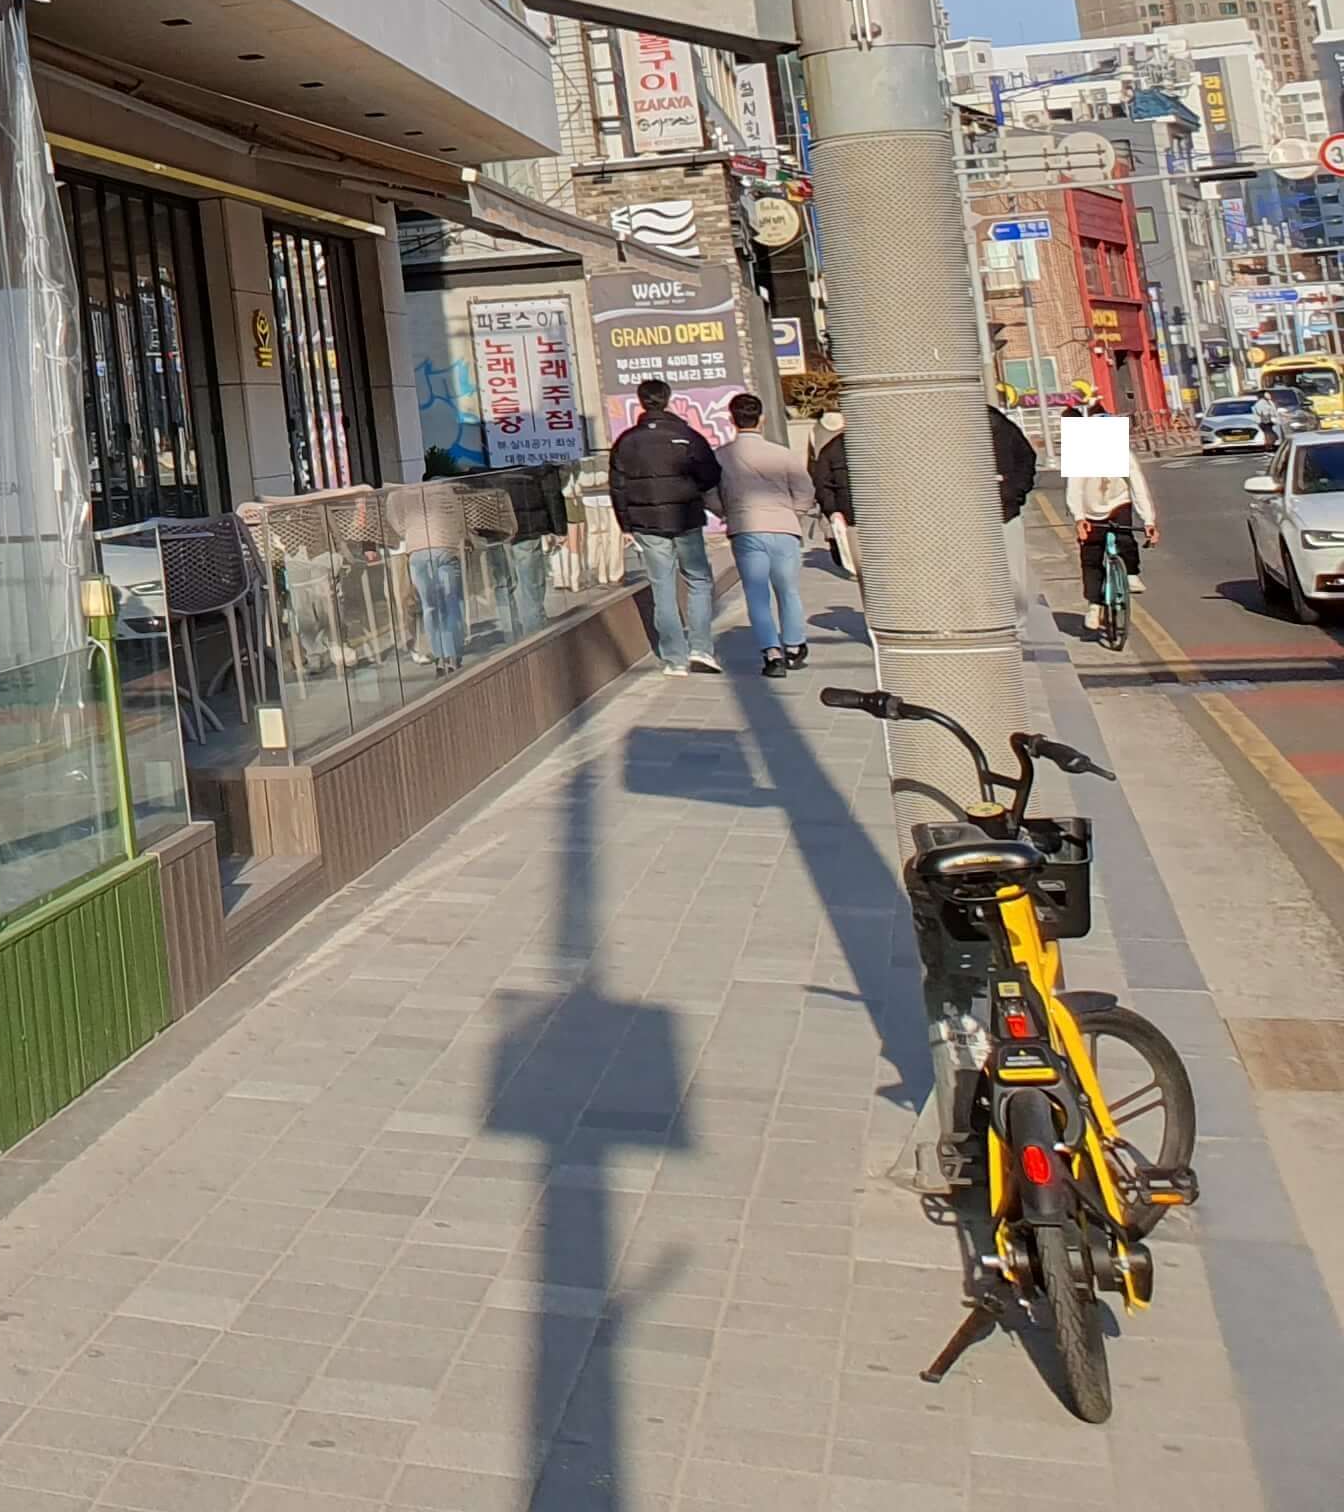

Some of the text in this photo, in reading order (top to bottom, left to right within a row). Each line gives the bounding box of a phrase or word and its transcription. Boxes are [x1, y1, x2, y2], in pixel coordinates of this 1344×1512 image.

[633, 96, 694, 113] IZAKAYA
[1203, 75, 1229, 123] 라이브
[632, 281, 684, 299] WAVE
[476, 311, 533, 331] 파로스
[610, 321, 725, 347] GRAND OPEN
[616, 356, 663, 371] 부산최대
[700, 351, 726, 366] 규모
[485, 338, 525, 435] 노래연습장
[537, 335, 574, 431] 노래주점
